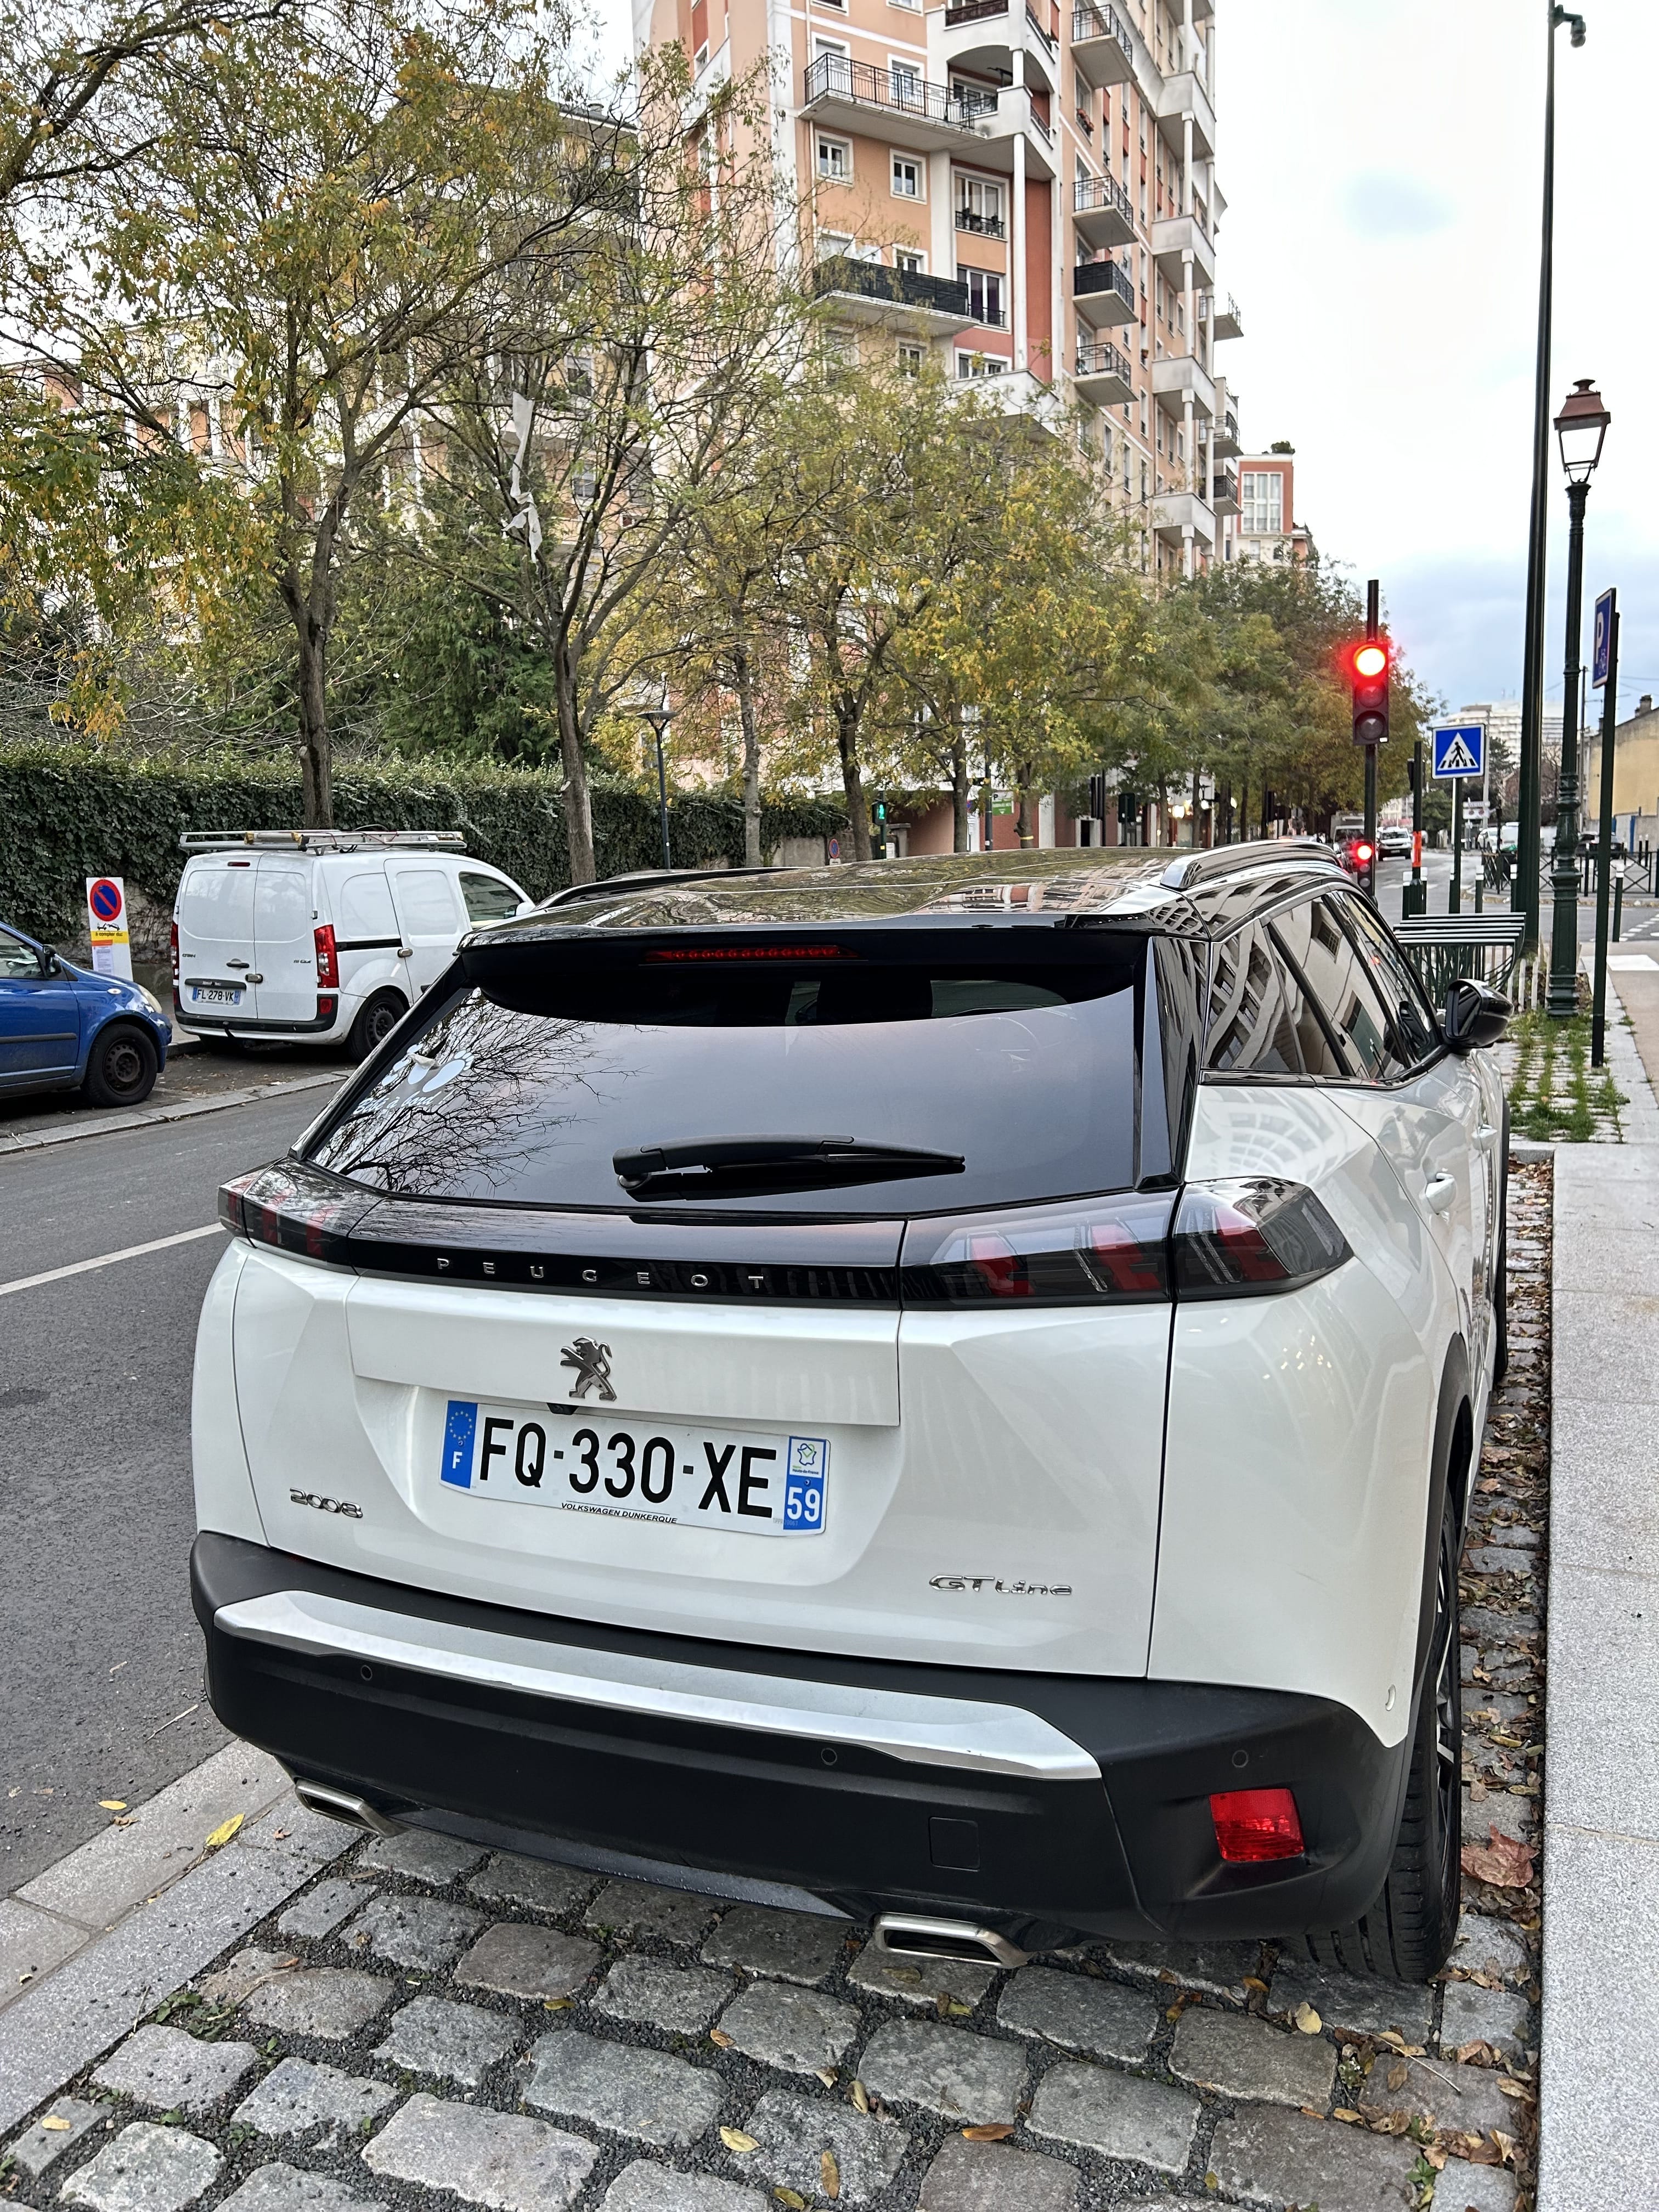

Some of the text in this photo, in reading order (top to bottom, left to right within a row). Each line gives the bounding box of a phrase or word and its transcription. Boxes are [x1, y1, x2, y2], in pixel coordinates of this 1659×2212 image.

[1596, 611, 1604, 664] P
[387, 1096, 400, 1109] à
[437, 1258, 764, 1289] PEUGEOT
[452, 1451, 462, 1469] F
[480, 1417, 777, 1519] FQ-330-XE
[290, 1482, 363, 1518] 2008
[561, 1503, 678, 1524] VOLKSWAGEN DUNKERQUE
[787, 1487, 820, 1522] 59
